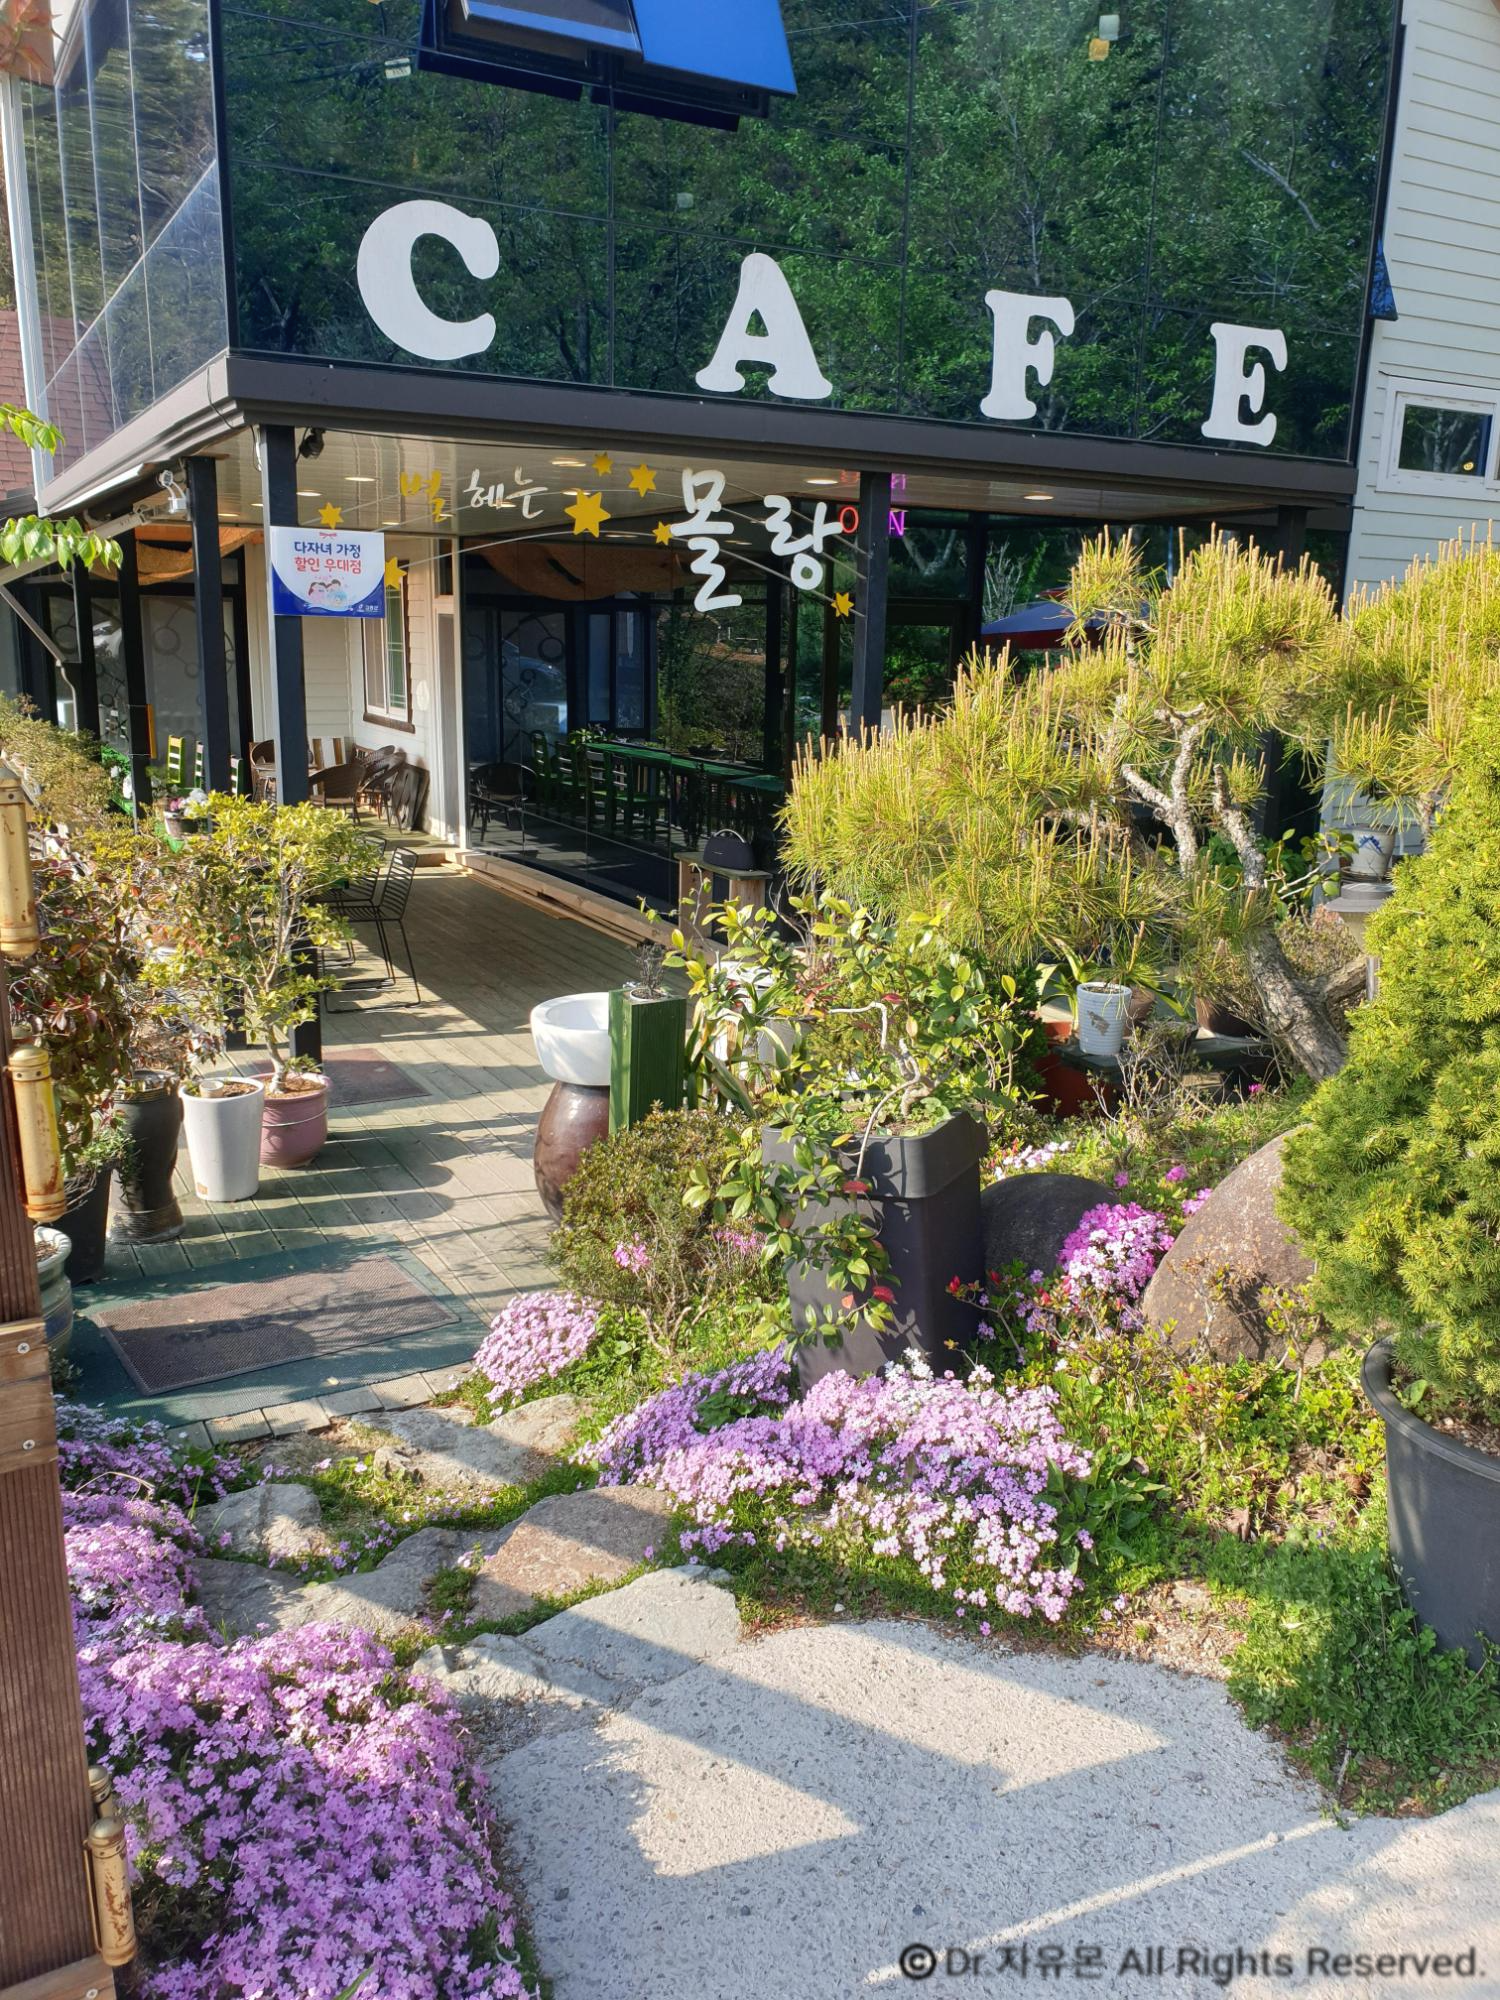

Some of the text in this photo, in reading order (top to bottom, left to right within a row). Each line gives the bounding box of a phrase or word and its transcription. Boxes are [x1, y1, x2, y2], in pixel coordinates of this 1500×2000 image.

[357, 199, 1288, 446] CAFE
[839, 505, 906, 537] ON
[294, 541, 361, 559] 다자녀 가정
[400, 465, 844, 613] 별 헤는 몰랑
[294, 556, 362, 575] 할인 우대점
